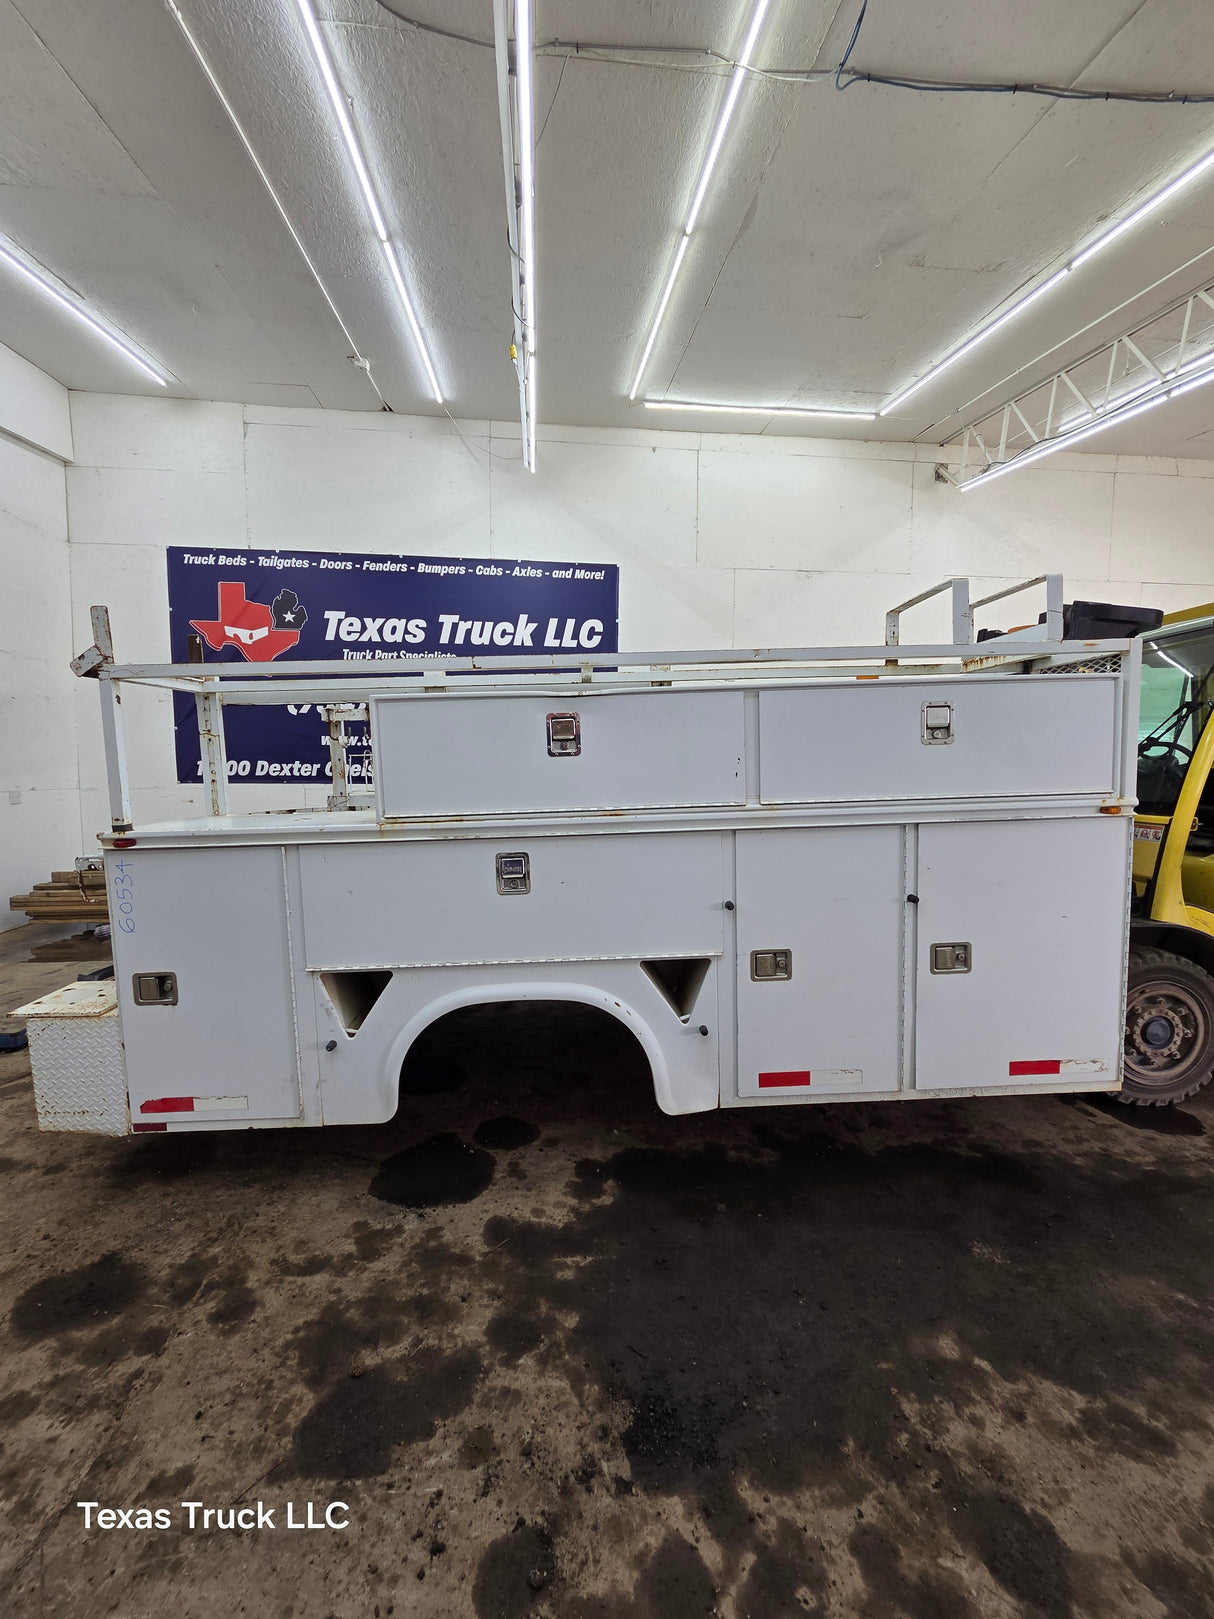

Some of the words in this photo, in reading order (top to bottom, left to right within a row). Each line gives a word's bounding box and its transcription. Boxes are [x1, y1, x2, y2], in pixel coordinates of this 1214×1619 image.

[183, 553, 216, 565] Truck
[217, 554, 248, 566] Beds
[257, 555, 310, 570] Tailgates
[319, 558, 353, 570] Doors
[362, 560, 408, 572] Fenders
[417, 562, 466, 577] Bumpers
[475, 564, 504, 576] Cabs
[511, 566, 543, 578] Axles
[551, 567, 574, 579] and
[574, 569, 605, 580] More!
[323, 610, 427, 644] Texas
[438, 613, 539, 647] Truck
[543, 617, 604, 649] LLC
[342, 648, 373, 660] Truck
[375, 649, 398, 660] Part
[196, 759, 251, 777] 100
[255, 760, 321, 777] Dexter
[114, 858, 136, 934] 60534
